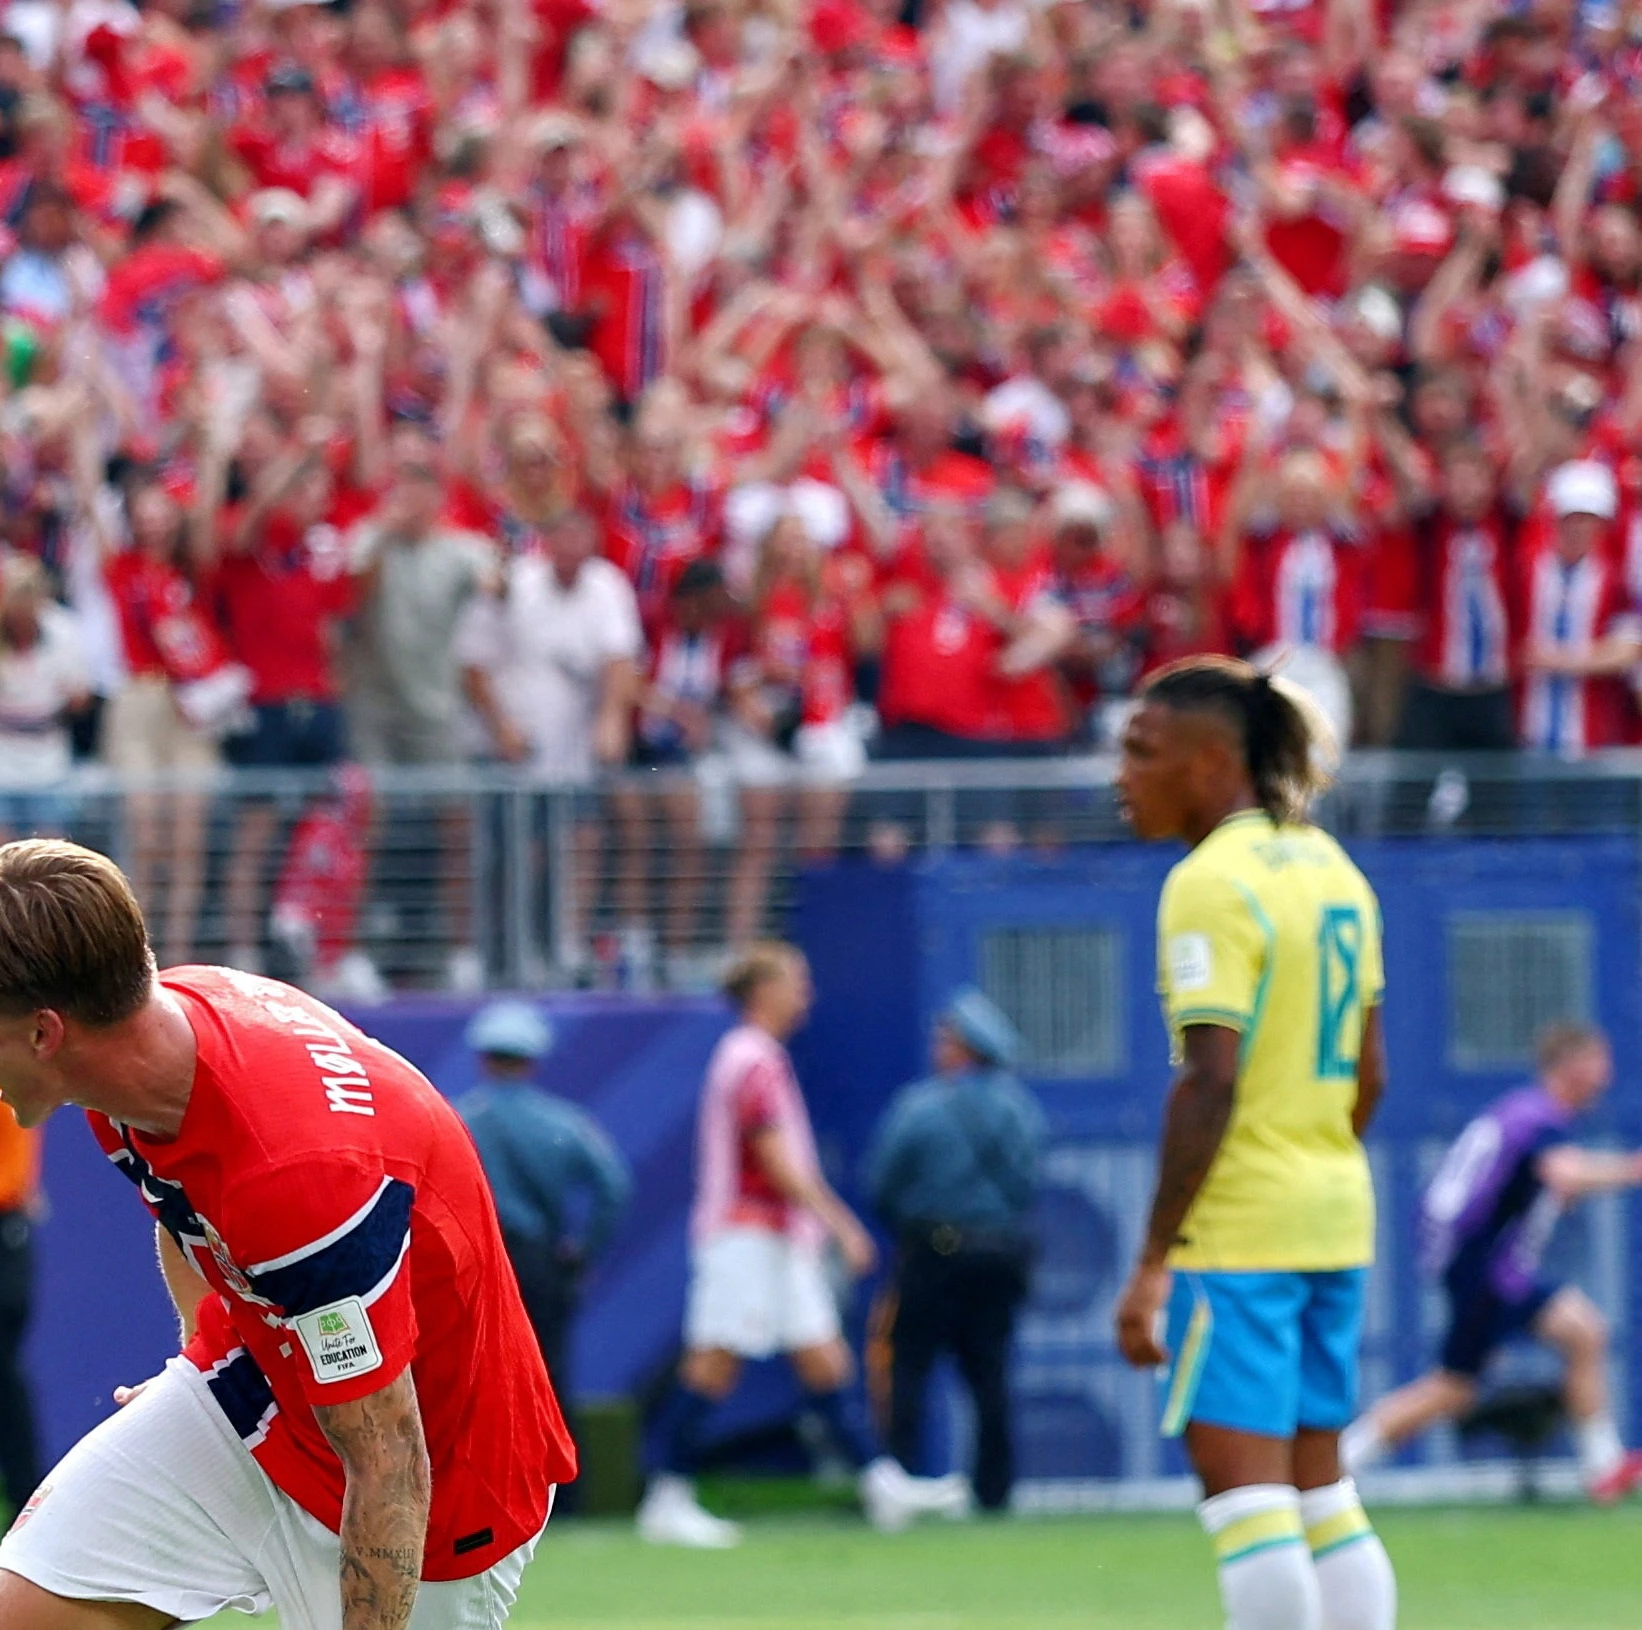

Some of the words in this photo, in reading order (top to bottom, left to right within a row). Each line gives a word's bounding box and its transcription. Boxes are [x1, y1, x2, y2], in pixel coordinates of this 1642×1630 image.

[322, 1338, 342, 1350] Unite
[343, 1334, 355, 1347] For
[320, 1345, 367, 1365] EDUCATION
[338, 1362, 355, 1370] FIFA
